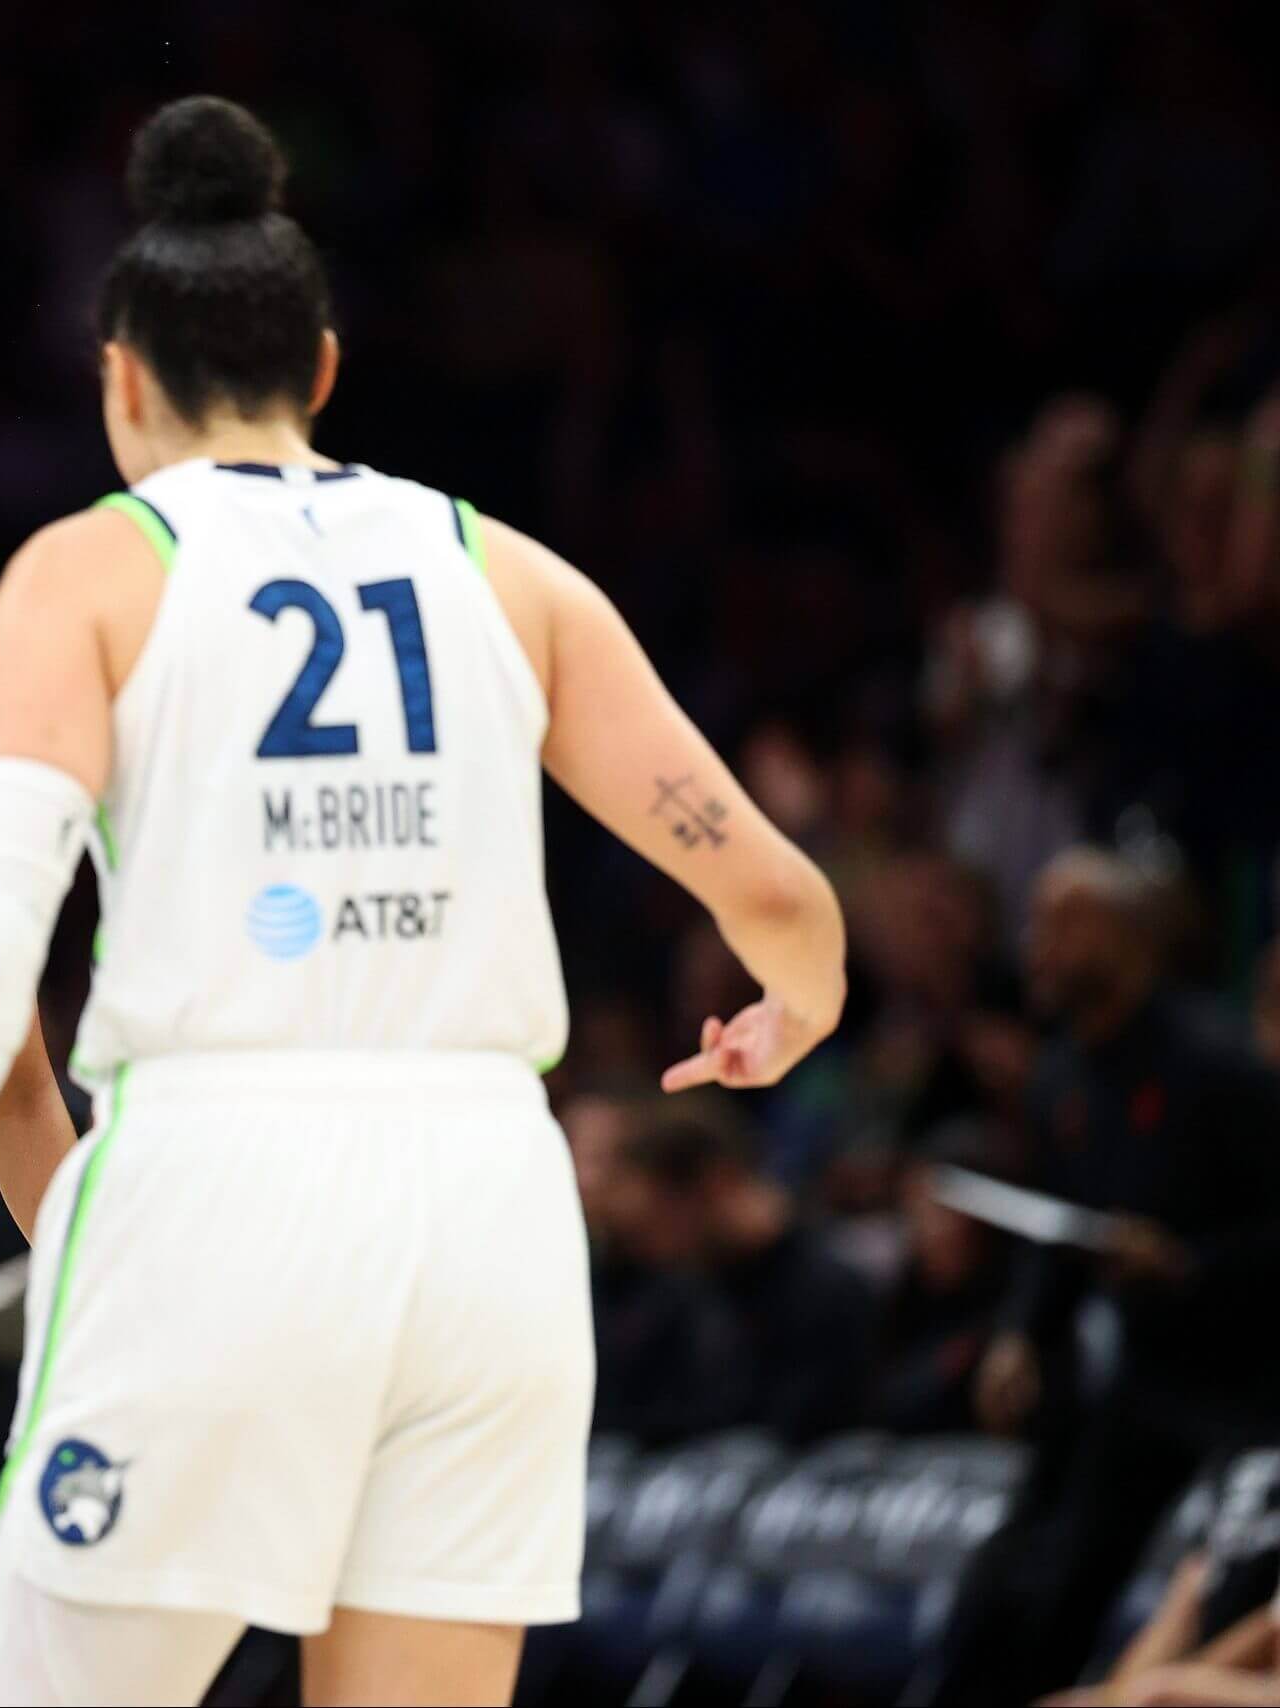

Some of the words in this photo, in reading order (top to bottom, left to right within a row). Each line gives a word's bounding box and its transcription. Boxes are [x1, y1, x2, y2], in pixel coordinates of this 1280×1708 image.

[248, 577, 437, 760] 21
[262, 782, 439, 852] McBRIDE
[332, 891, 451, 942] AT&T
